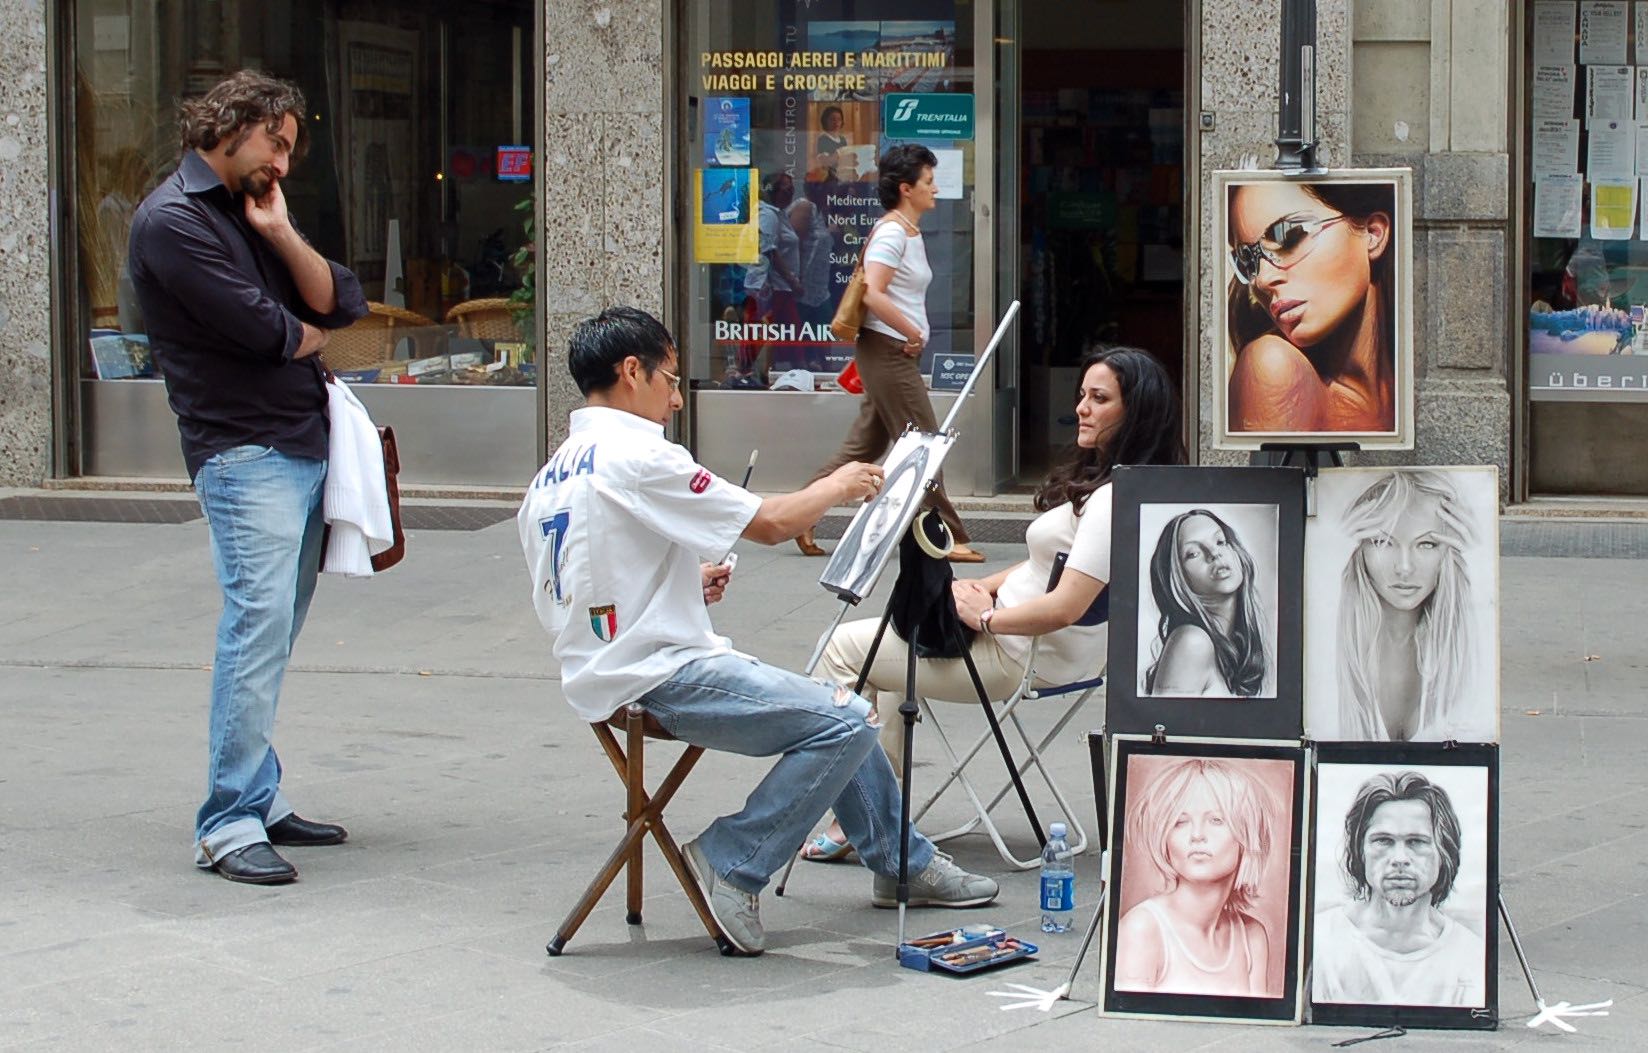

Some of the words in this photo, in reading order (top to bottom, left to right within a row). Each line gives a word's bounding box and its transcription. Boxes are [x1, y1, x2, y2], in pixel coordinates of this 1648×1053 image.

[701, 52, 784, 68] PASSAGGI
[791, 52, 838, 68] AEREI
[845, 52, 855, 68] E
[861, 52, 946, 68] MARITTIMI
[702, 74, 757, 90] VIAGGI
[766, 74, 775, 90] E
[784, 74, 866, 90] CROCIERE
[785, 96, 797, 155] CENTRO
[916, 113, 968, 122] TRENITALIA
[828, 214, 857, 226] Nord
[829, 253, 849, 264] Sud
[715, 320, 796, 341] BRITISH
[798, 321, 838, 341] AIR
[538, 507, 572, 602] 7
